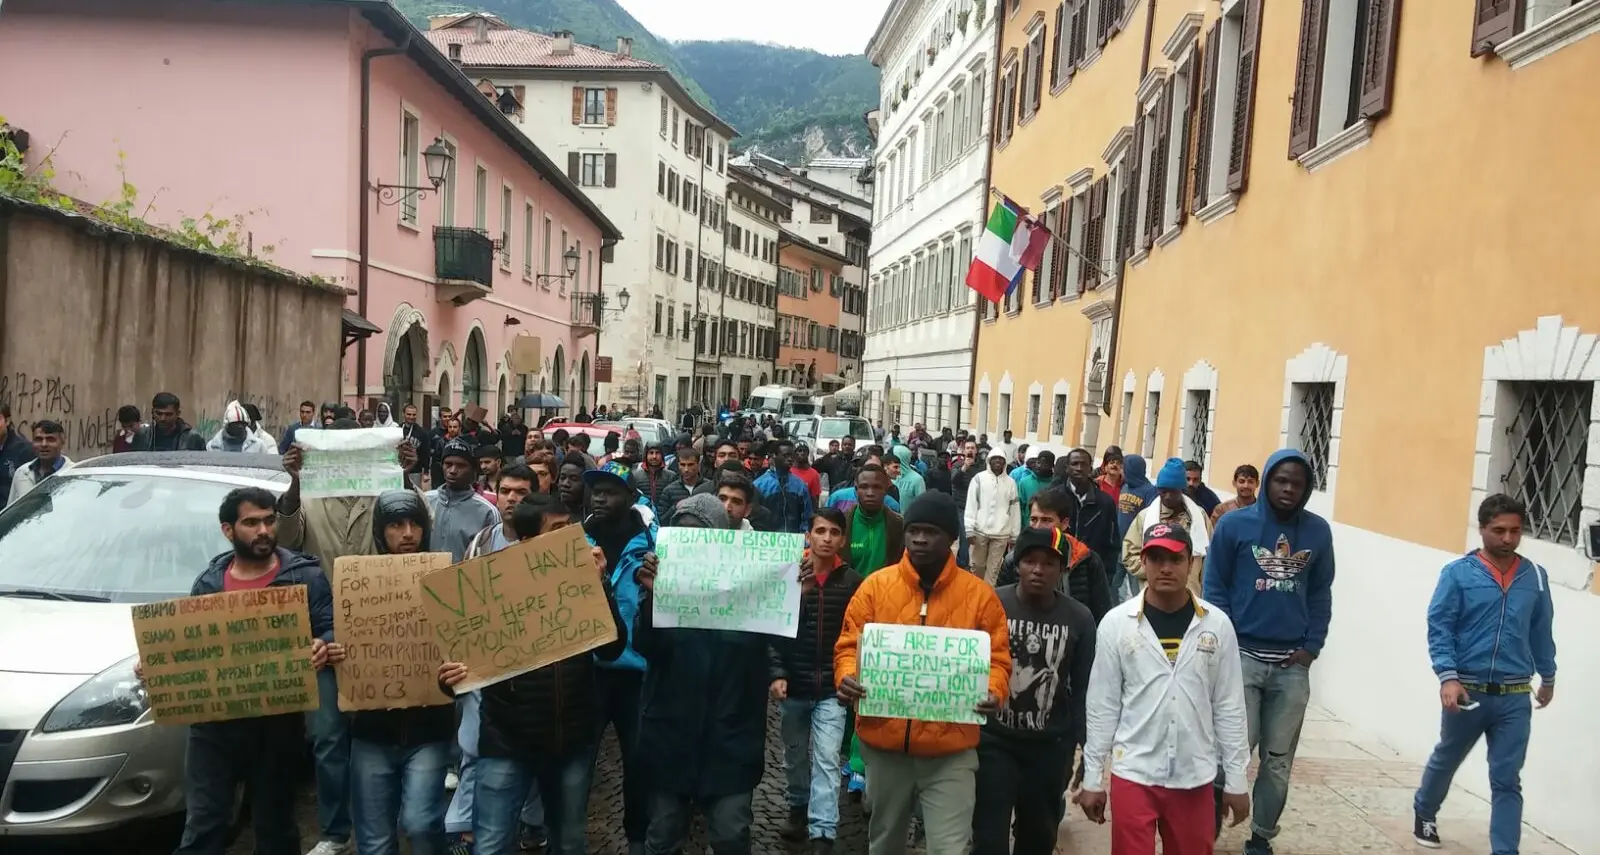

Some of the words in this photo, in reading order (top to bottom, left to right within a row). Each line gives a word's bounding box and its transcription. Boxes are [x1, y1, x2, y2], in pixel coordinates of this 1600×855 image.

[667, 528, 735, 545] BBIAMO
[342, 561, 359, 574] WE
[422, 557, 504, 618] WE
[524, 537, 588, 581] HAVE
[340, 577, 370, 596] FOR
[377, 574, 401, 589] THE
[435, 613, 491, 643] BEEN
[500, 593, 548, 623] HERE
[557, 580, 594, 605] FOR
[540, 606, 572, 632] NO
[142, 628, 176, 645] SIAMO
[264, 612, 298, 630] TEMPO
[1007, 618, 1069, 641] MERICAN
[492, 617, 608, 669] QUESTURA
[861, 628, 895, 649] WE
[903, 631, 938, 651] ARE
[944, 636, 979, 657] FOR
[346, 682, 376, 702] NO
[860, 668, 977, 692] PROTECTION
[860, 701, 884, 715] NO
